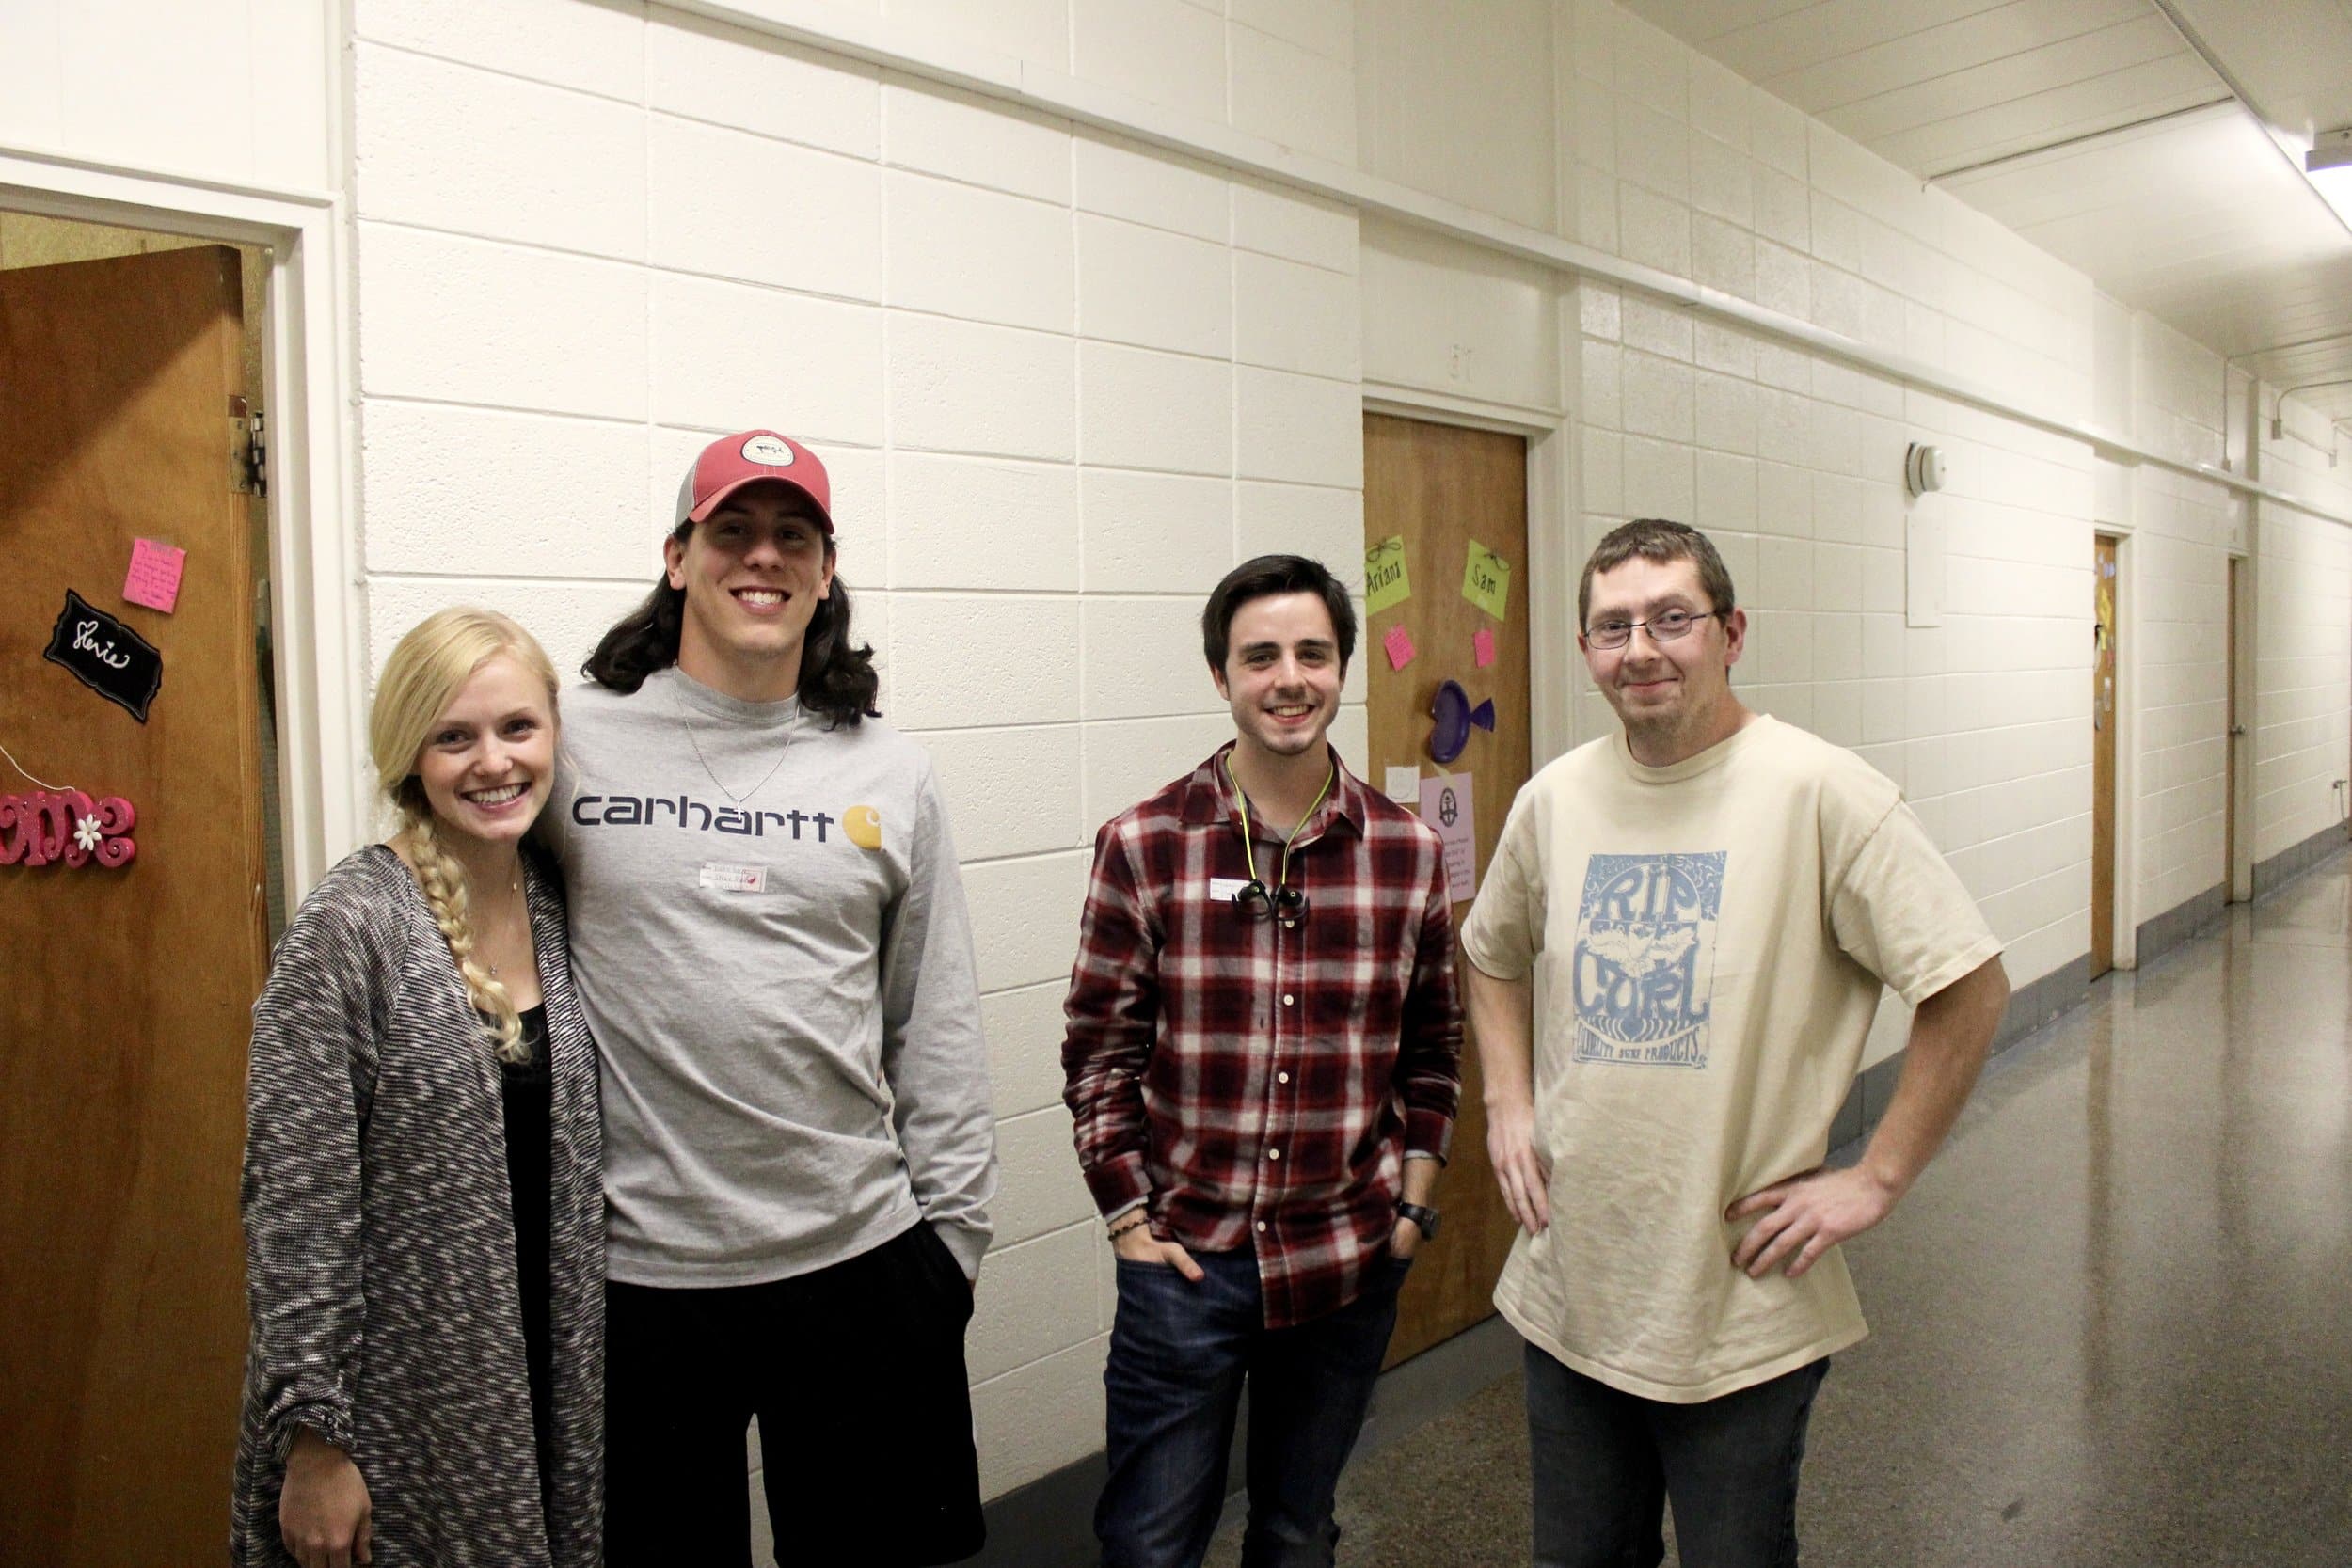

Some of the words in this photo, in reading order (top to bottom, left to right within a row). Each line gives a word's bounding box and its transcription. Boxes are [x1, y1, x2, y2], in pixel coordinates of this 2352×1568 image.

[1472, 563, 1497, 594] Sam
[572, 796, 834, 843] carhartt
[1594, 863, 1699, 922] RIP
[1645, 1025, 1700, 1062] PRODUCTS
